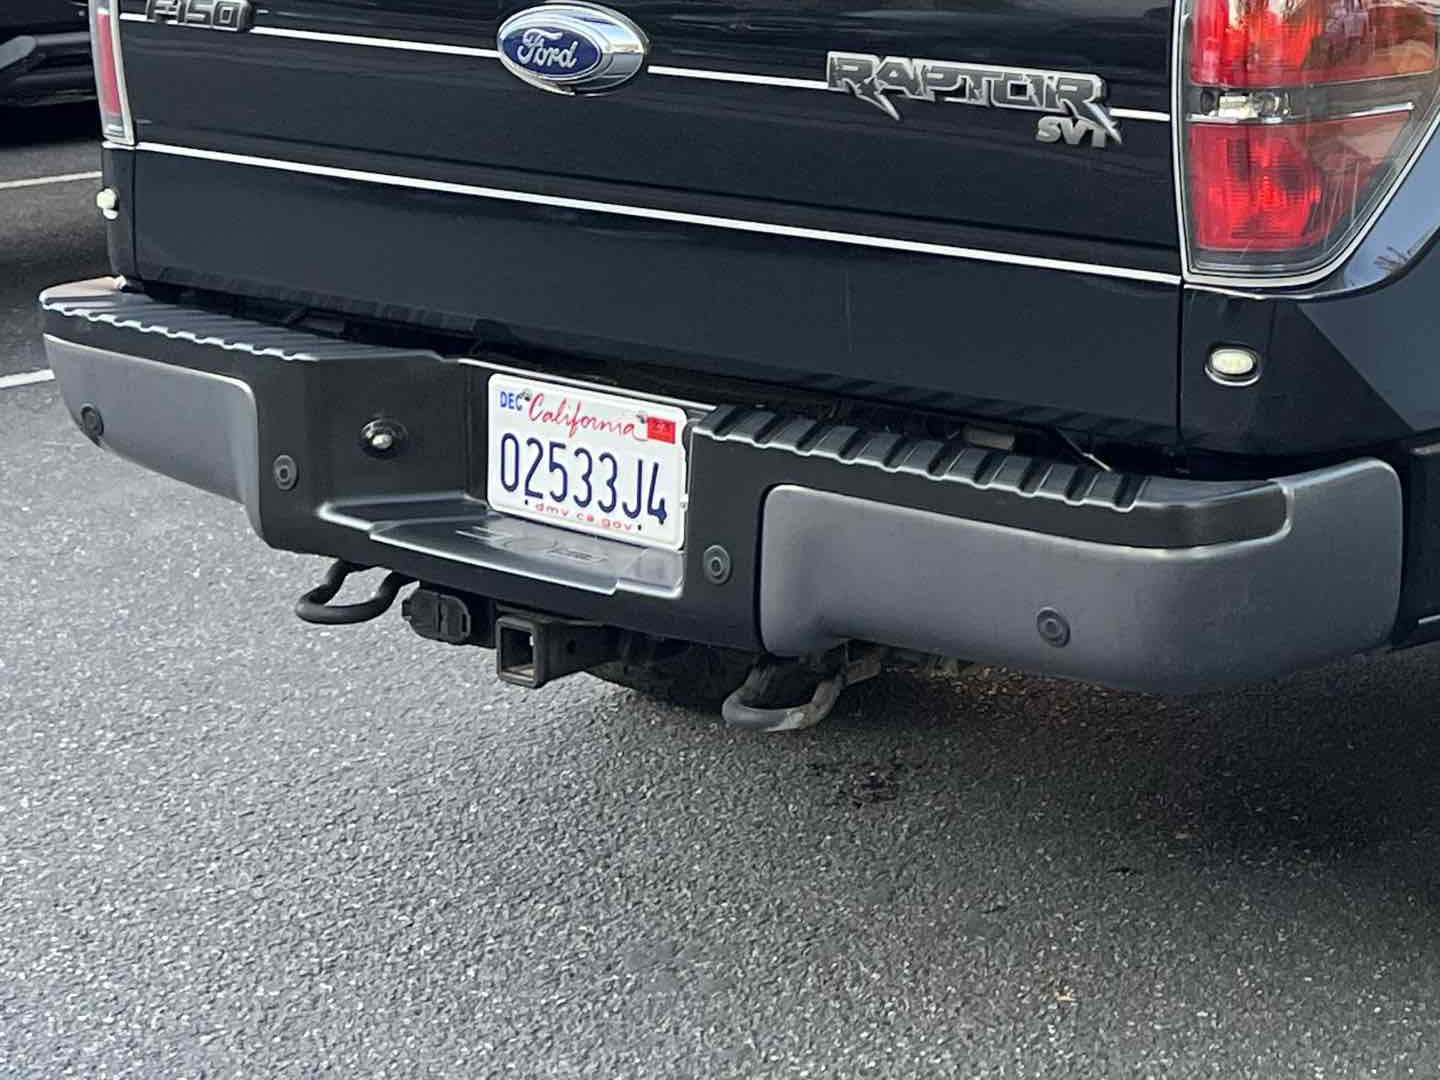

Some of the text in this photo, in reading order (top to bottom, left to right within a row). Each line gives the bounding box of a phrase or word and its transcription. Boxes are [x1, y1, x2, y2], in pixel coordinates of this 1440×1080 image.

[517, 28, 579, 69] Ford
[826, 51, 1121, 144] RAPTOR
[1036, 116, 1118, 148] SVT
[500, 391, 523, 411] DEC
[528, 393, 649, 441] California
[501, 432, 668, 526] 02533J4
